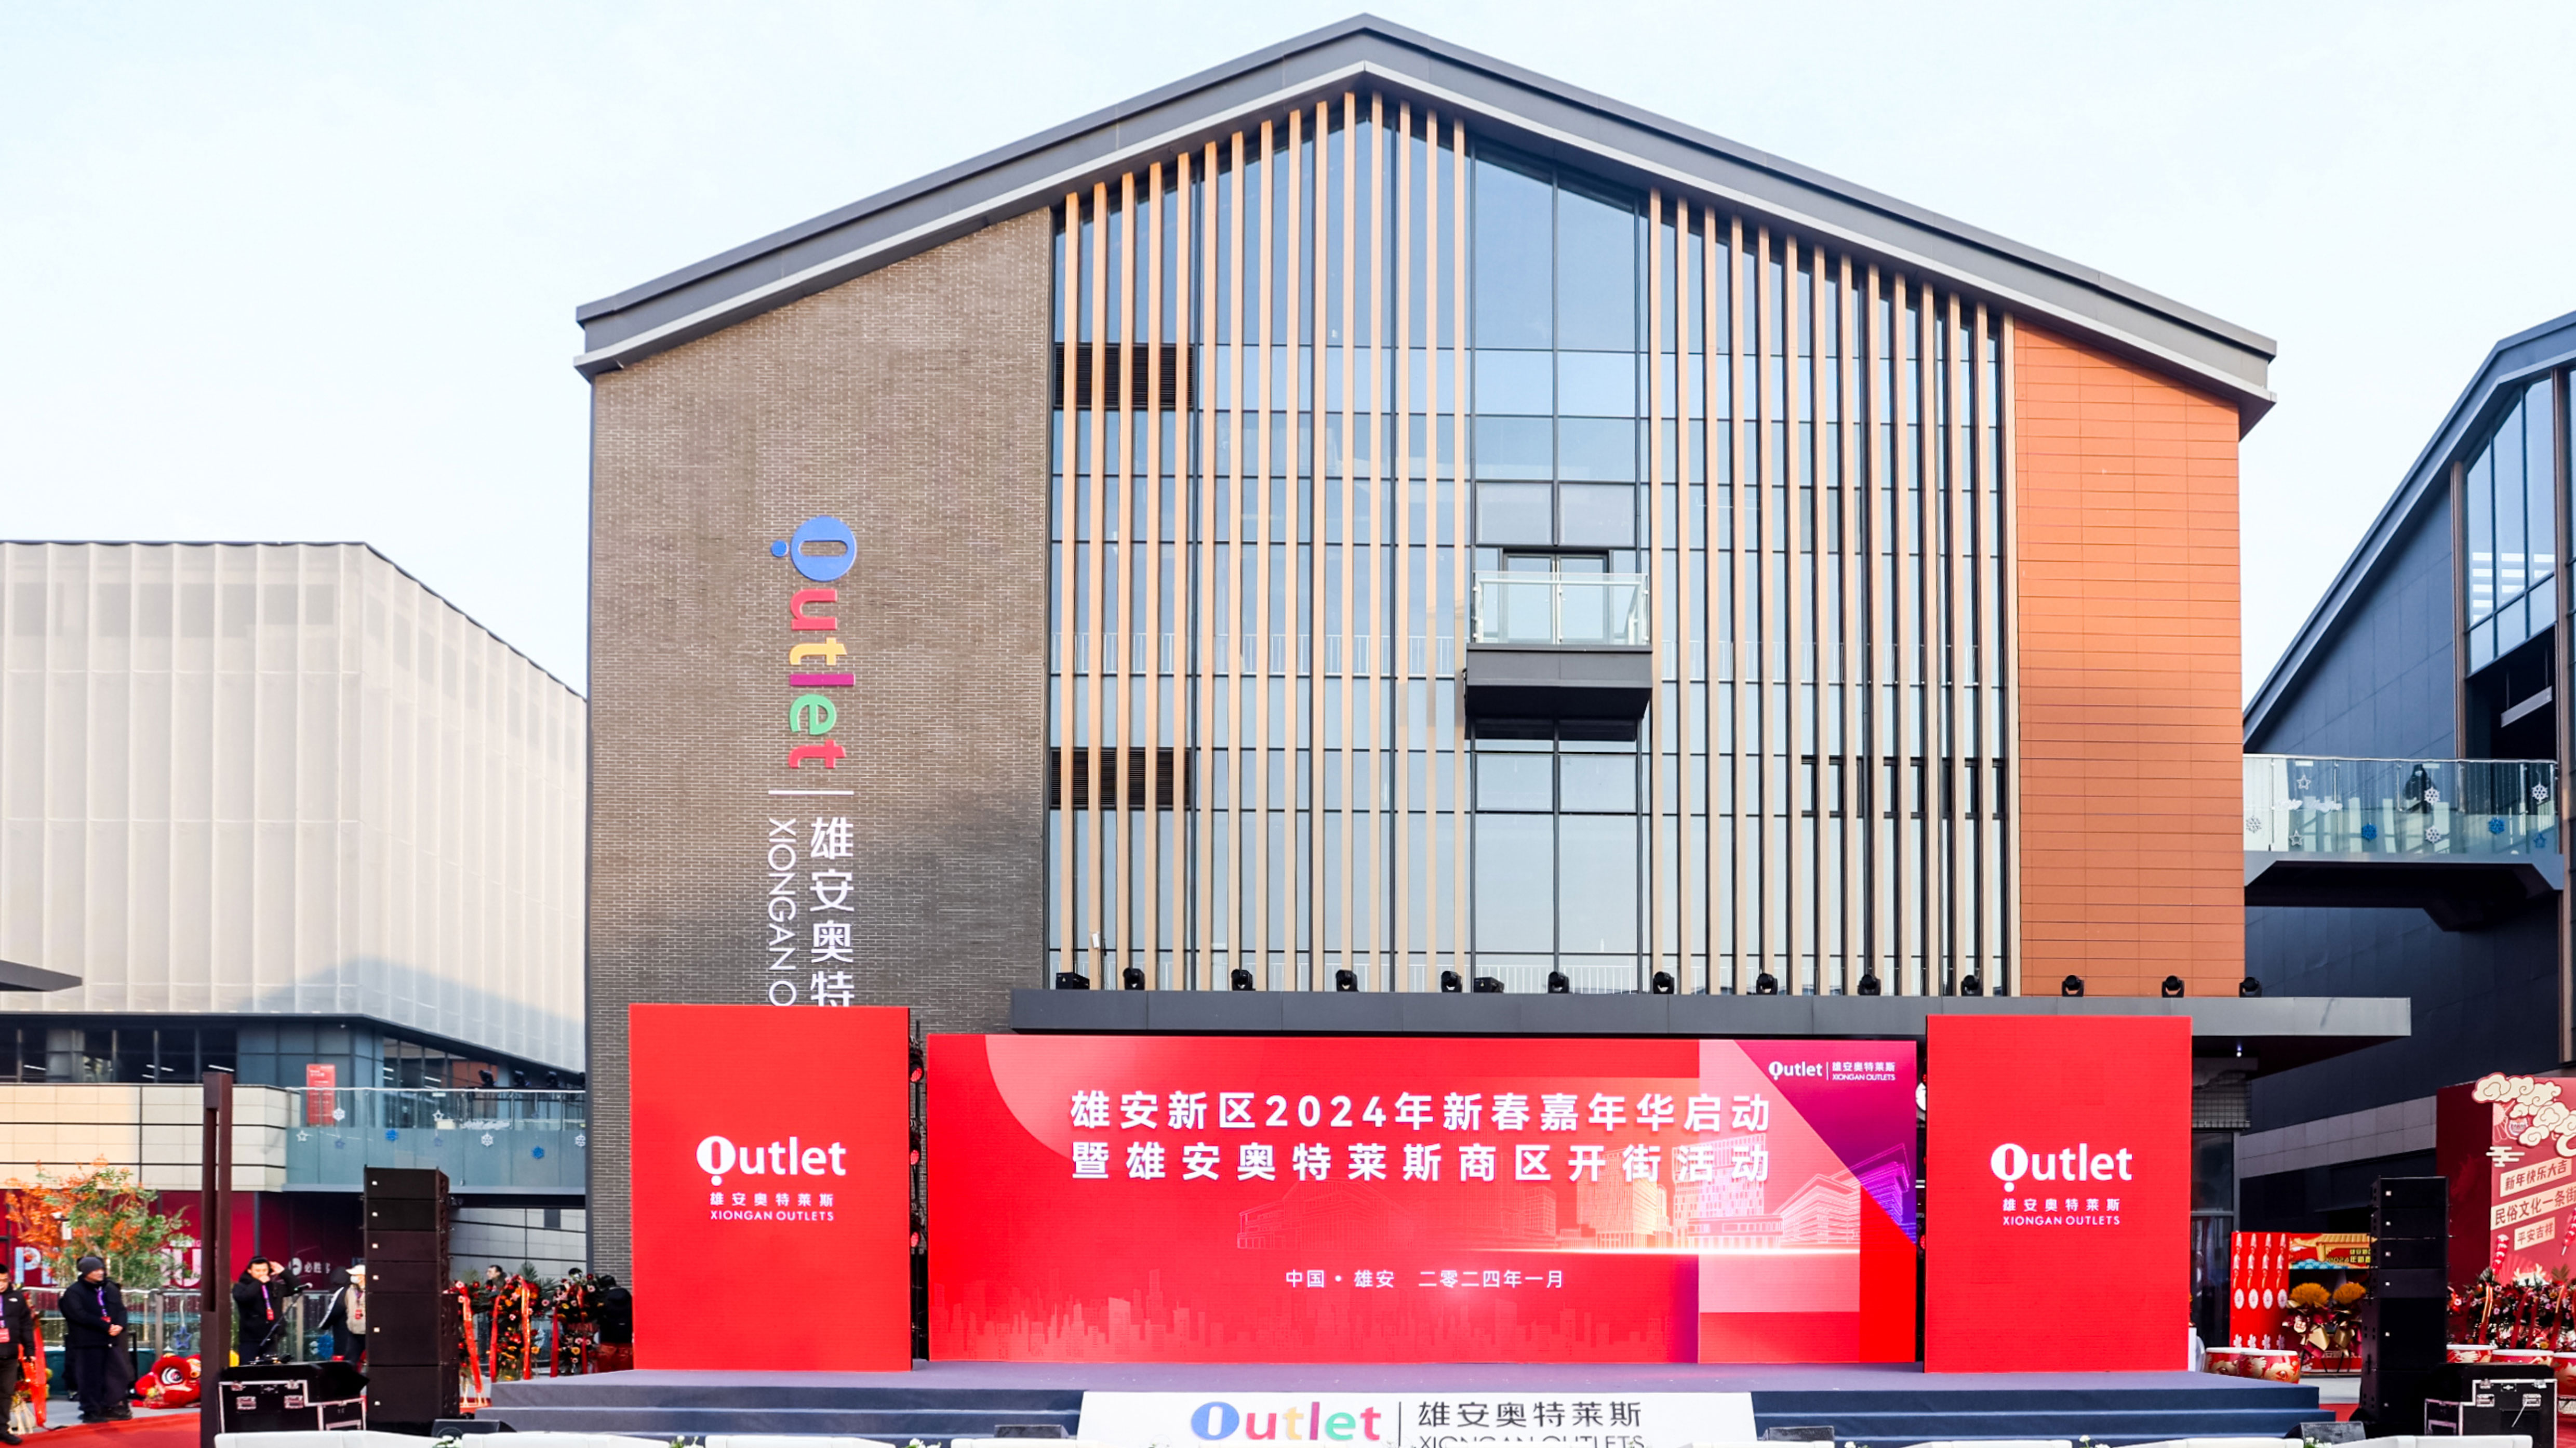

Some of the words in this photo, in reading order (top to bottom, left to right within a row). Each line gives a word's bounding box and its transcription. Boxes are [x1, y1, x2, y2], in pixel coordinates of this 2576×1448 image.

[771, 515, 857, 769] Outlet
[768, 817, 796, 970] XIONGAN
[810, 817, 855, 1006] 雄安奥特
[1769, 1061, 1822, 1080] Outlet
[1832, 1061, 1895, 1071] 雄安奥特莱斯
[1071, 1091, 1769, 1132] 雄安新区2024年新春嘉年华启动
[696, 1135, 846, 1186] Outlet
[1072, 1142, 1769, 1182] 暨雄安奥特莱斯商区开街活动
[1991, 1143, 2132, 1192] Outlet
[2504, 1160, 2568, 1191] 新年快乐大吉
[710, 1192, 833, 1207] 雄安奥特莱斯
[2003, 1198, 2120, 1212] 雄安奥特莱斯
[2495, 1186, 2576, 1226] 民俗文化一条街
[711, 1210, 772, 1220] XIONGAN
[776, 1211, 834, 1221] OUTLETS
[2003, 1216, 2062, 1226] XIONGAN
[2066, 1216, 2120, 1225] OUTLETS
[2517, 1222, 2554, 1245] 平安吉祥
[1419, 1270, 1563, 1288] 二零二四年一月
[1191, 1401, 1382, 1440] Outlet
[1418, 1401, 1641, 1427] 雄安奥特莱斯
